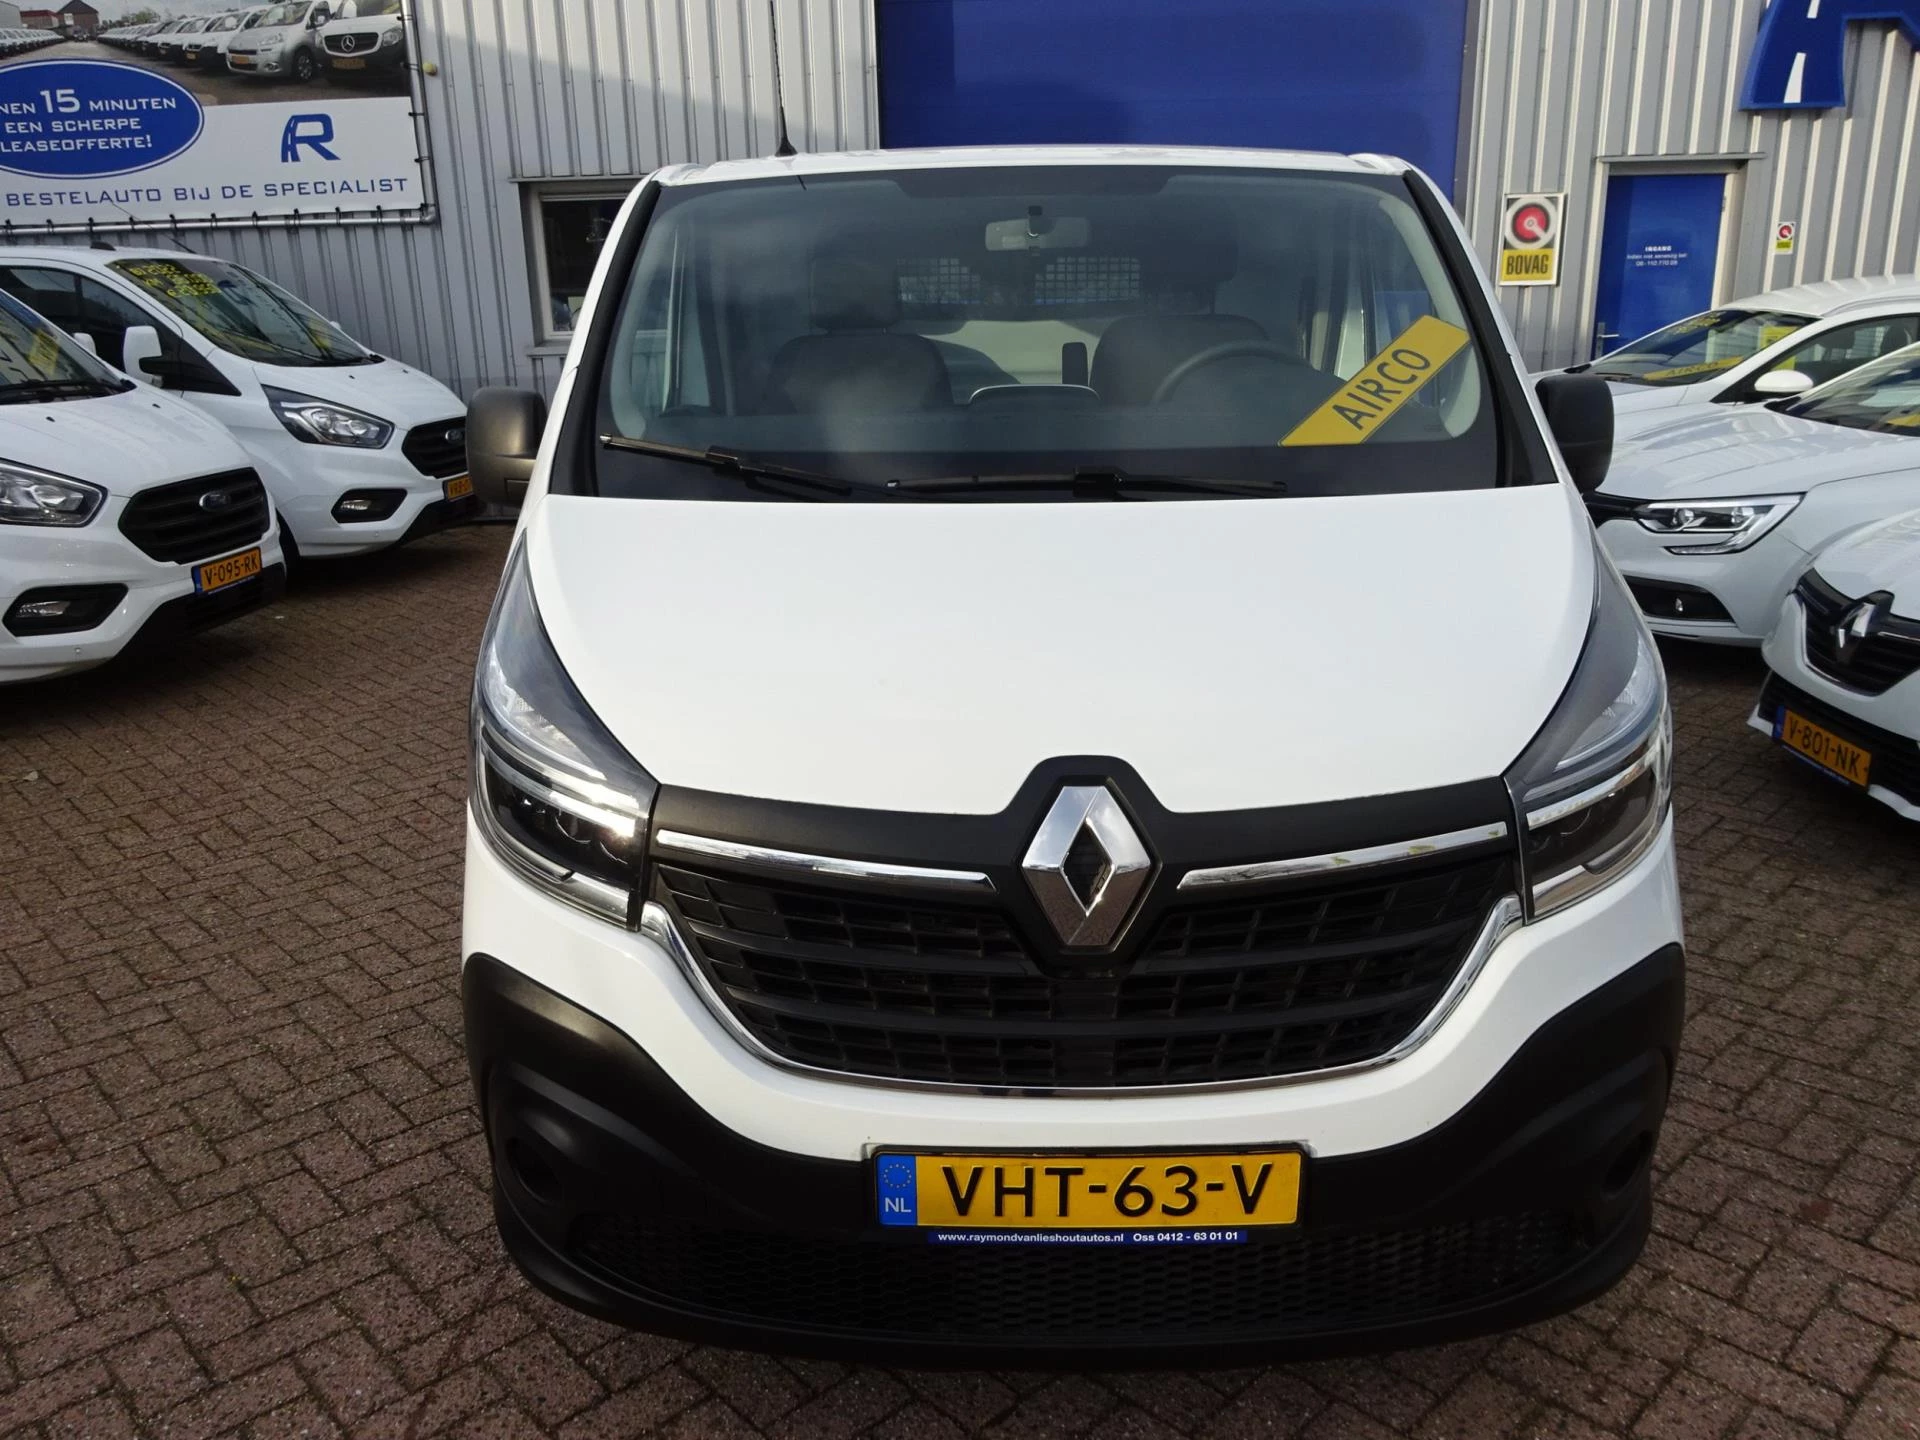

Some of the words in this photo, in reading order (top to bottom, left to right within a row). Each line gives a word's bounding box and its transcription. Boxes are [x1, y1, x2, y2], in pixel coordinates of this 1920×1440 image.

[40, 88, 81, 113] 15
[89, 97, 177, 112] MINUTEN
[5, 122, 43, 134] EEN
[51, 118, 142, 132] SCHERPE
[0, 134, 153, 152] LEASEOFFERTE!
[6, 188, 162, 206] BESTELAUTO
[174, 186, 210, 201] BIJ
[221, 184, 254, 199] DE
[264, 178, 408, 197] SPECIALIST
[1506, 254, 1549, 275] BOVAG
[1332, 348, 1431, 431] AIRCO
[204, 553, 259, 586] V-095-RK
[1789, 715, 1861, 777] V-801-NK
[942, 1163, 1273, 1217] VHT-63-V
[885, 1197, 912, 1213] NL
[938, 1232, 1124, 1243] www.raymondvanlieshoutautos.nl
[1133, 1232, 1155, 1242] Oss
[1157, 1232, 1184, 1242] 0412
[1193, 1231, 1208, 1241] 63
[1209, 1231, 1223, 1241] 01
[1225, 1231, 1239, 1241] 01
